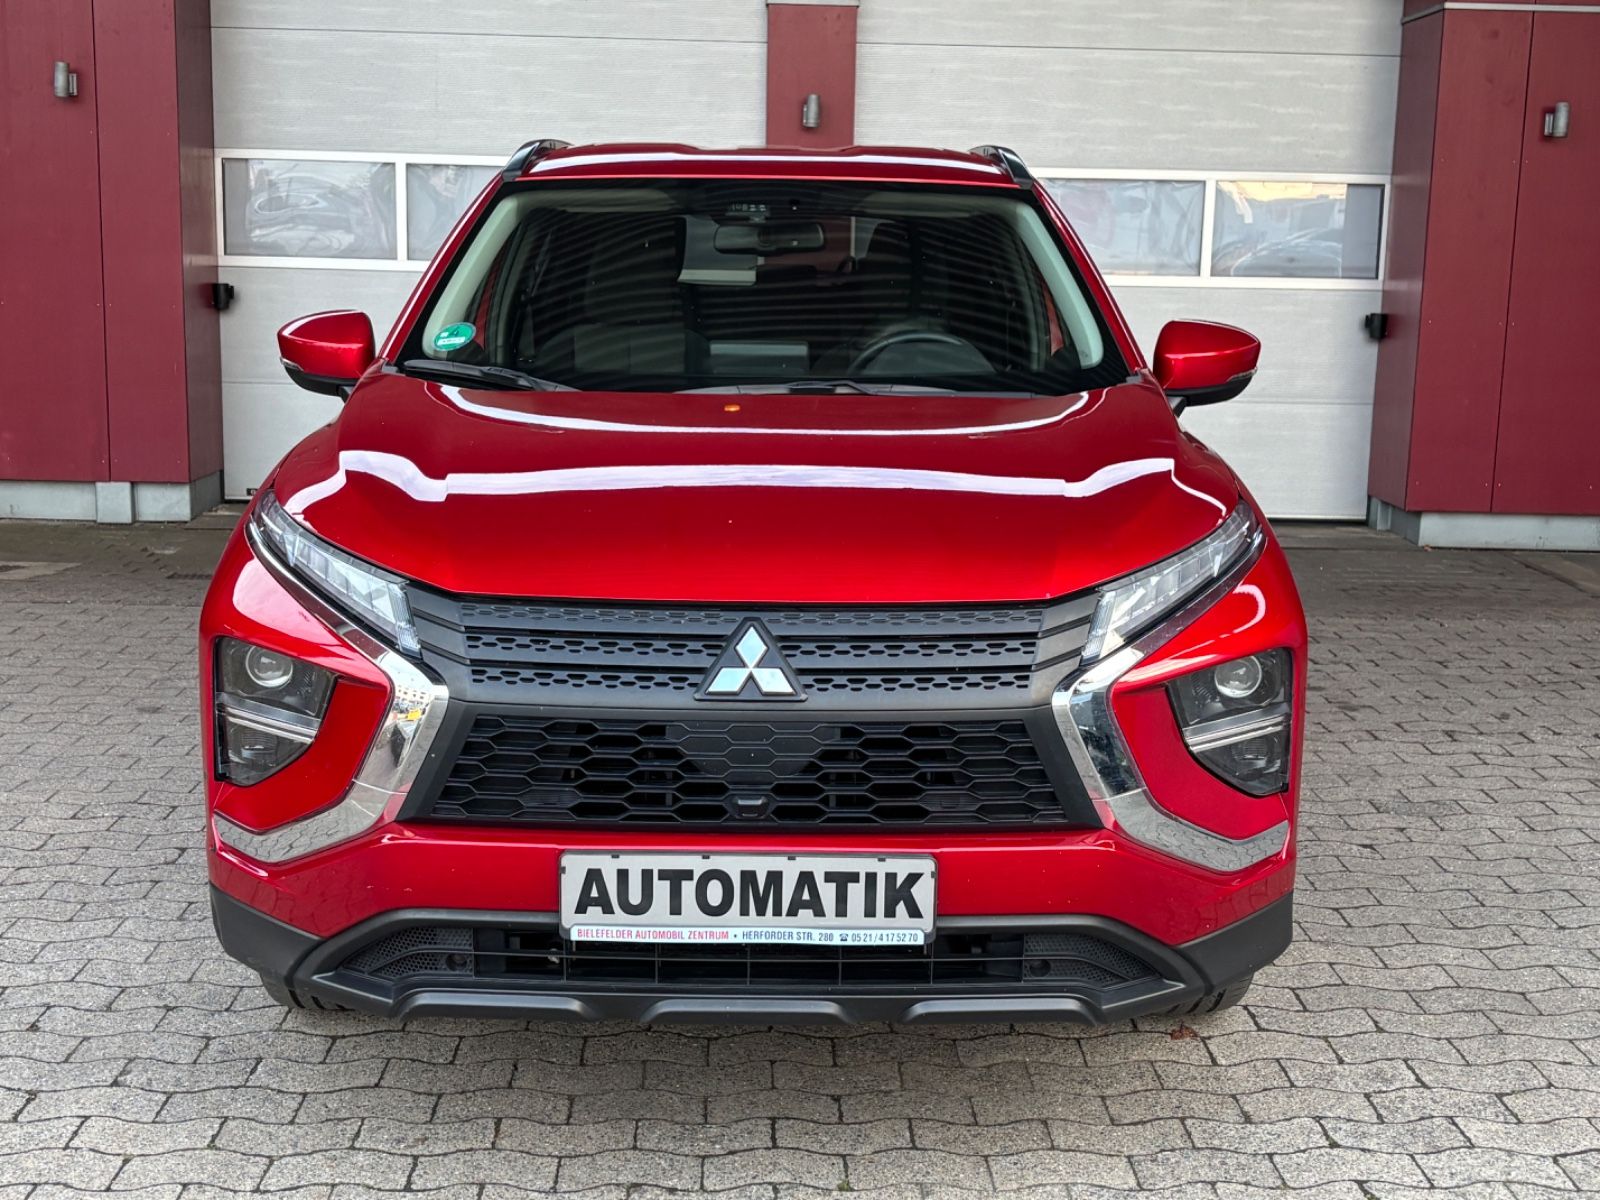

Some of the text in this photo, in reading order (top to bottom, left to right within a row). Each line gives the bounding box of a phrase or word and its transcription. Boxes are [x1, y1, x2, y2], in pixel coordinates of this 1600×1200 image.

[574, 868, 925, 919] AUTOMATIK
[577, 928, 633, 939] BIELEFELDER
[635, 929, 685, 940] AUTOMOBIL
[687, 930, 729, 940] ZENTRUM
[742, 930, 794, 941] HERFORDER
[796, 931, 816, 941] STR.
[818, 932, 834, 942] 280
